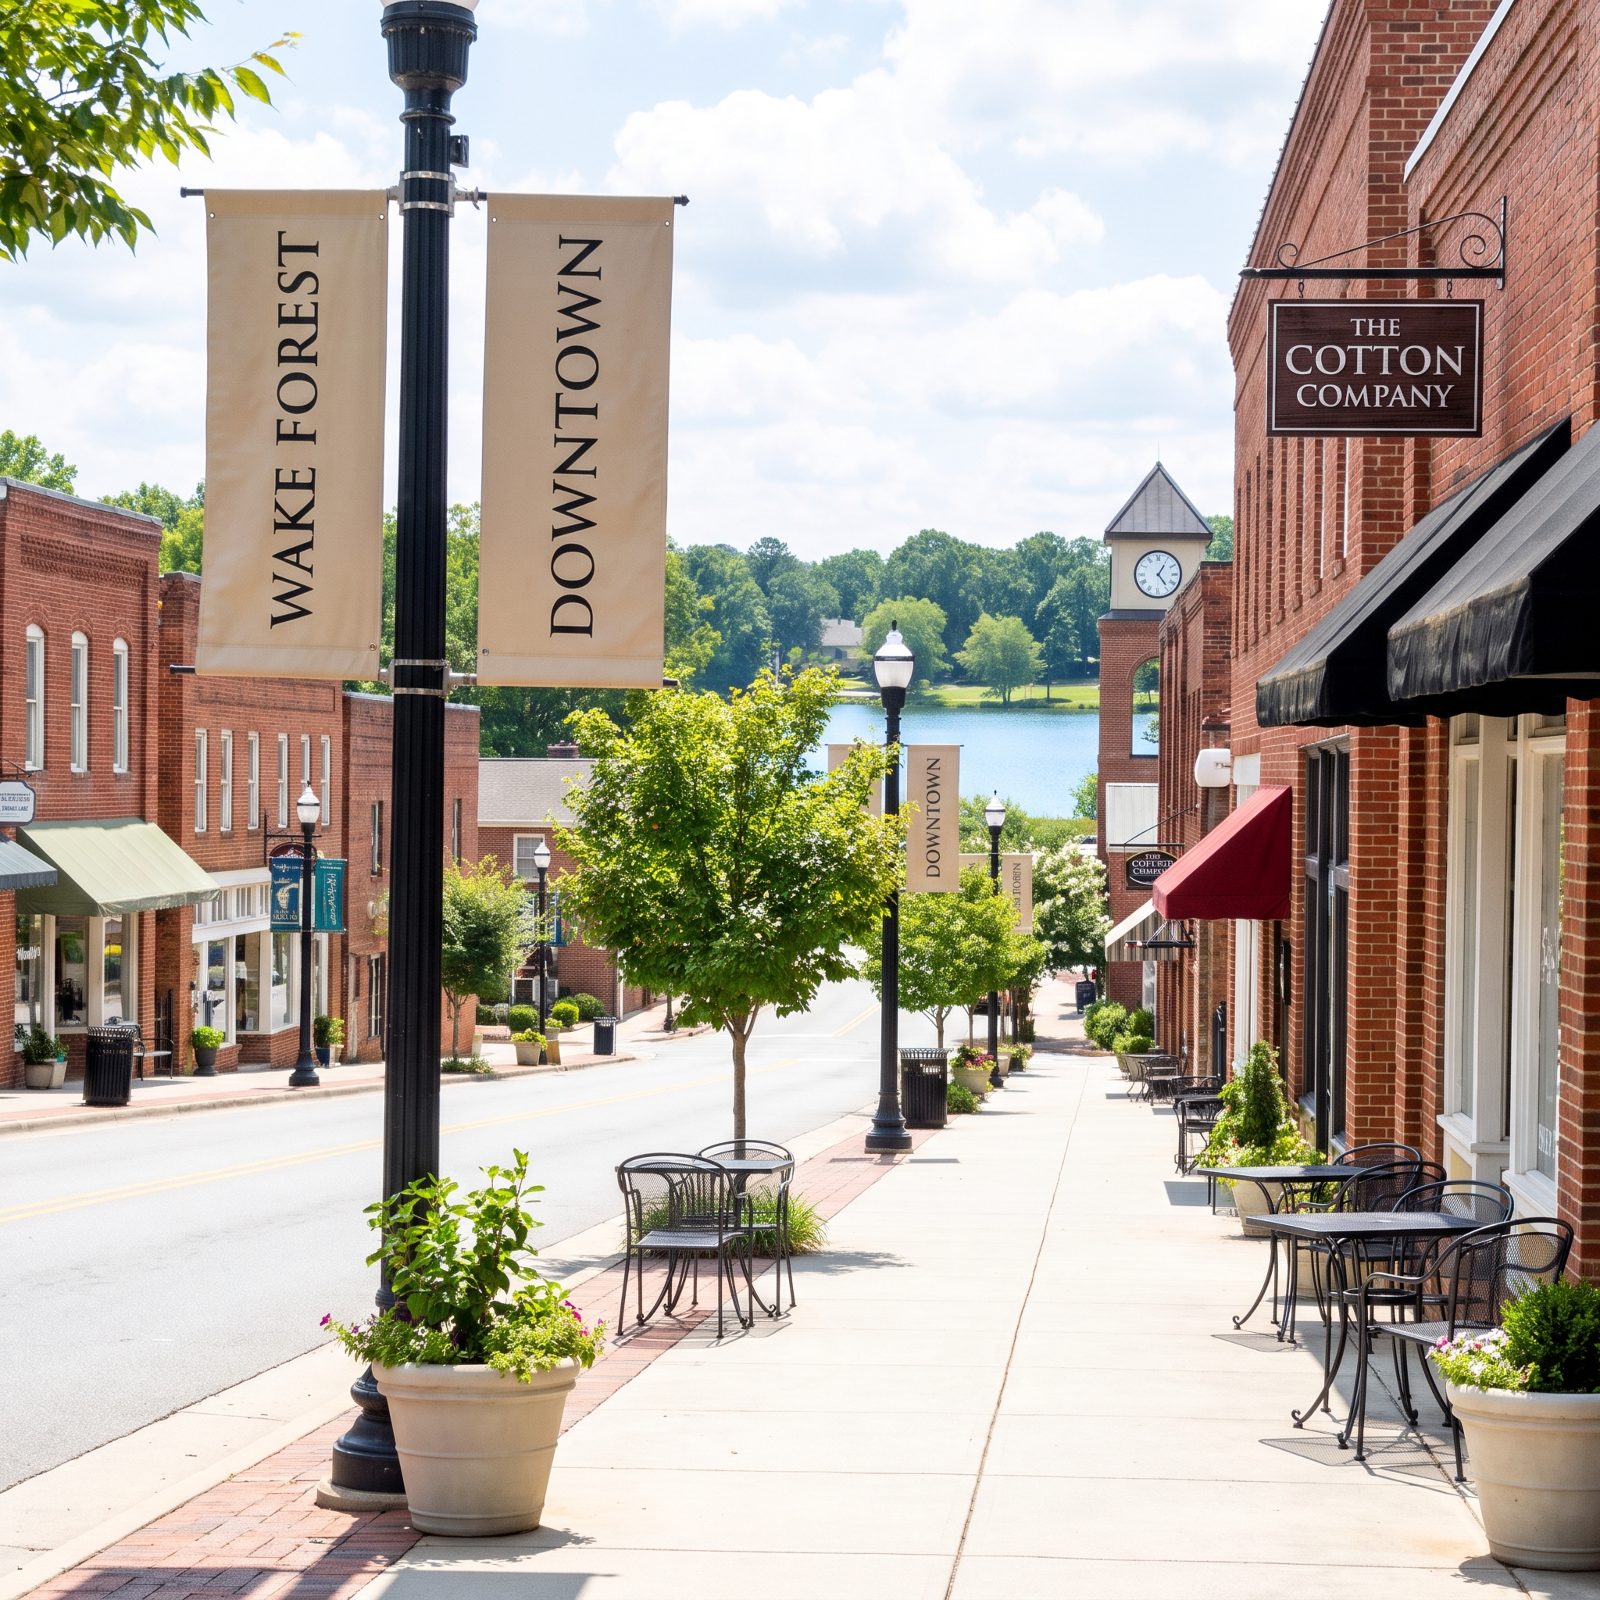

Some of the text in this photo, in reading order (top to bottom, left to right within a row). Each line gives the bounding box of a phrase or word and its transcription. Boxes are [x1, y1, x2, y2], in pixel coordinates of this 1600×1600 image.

[1285, 344, 1466, 376] COTTON
[1350, 318, 1401, 337] THE
[269, 230, 320, 630] WAKE FOREST
[1296, 383, 1455, 408] COMPANY
[549, 234, 604, 639] DOWNTOWN
[925, 758, 941, 878] DOWNTOWN
